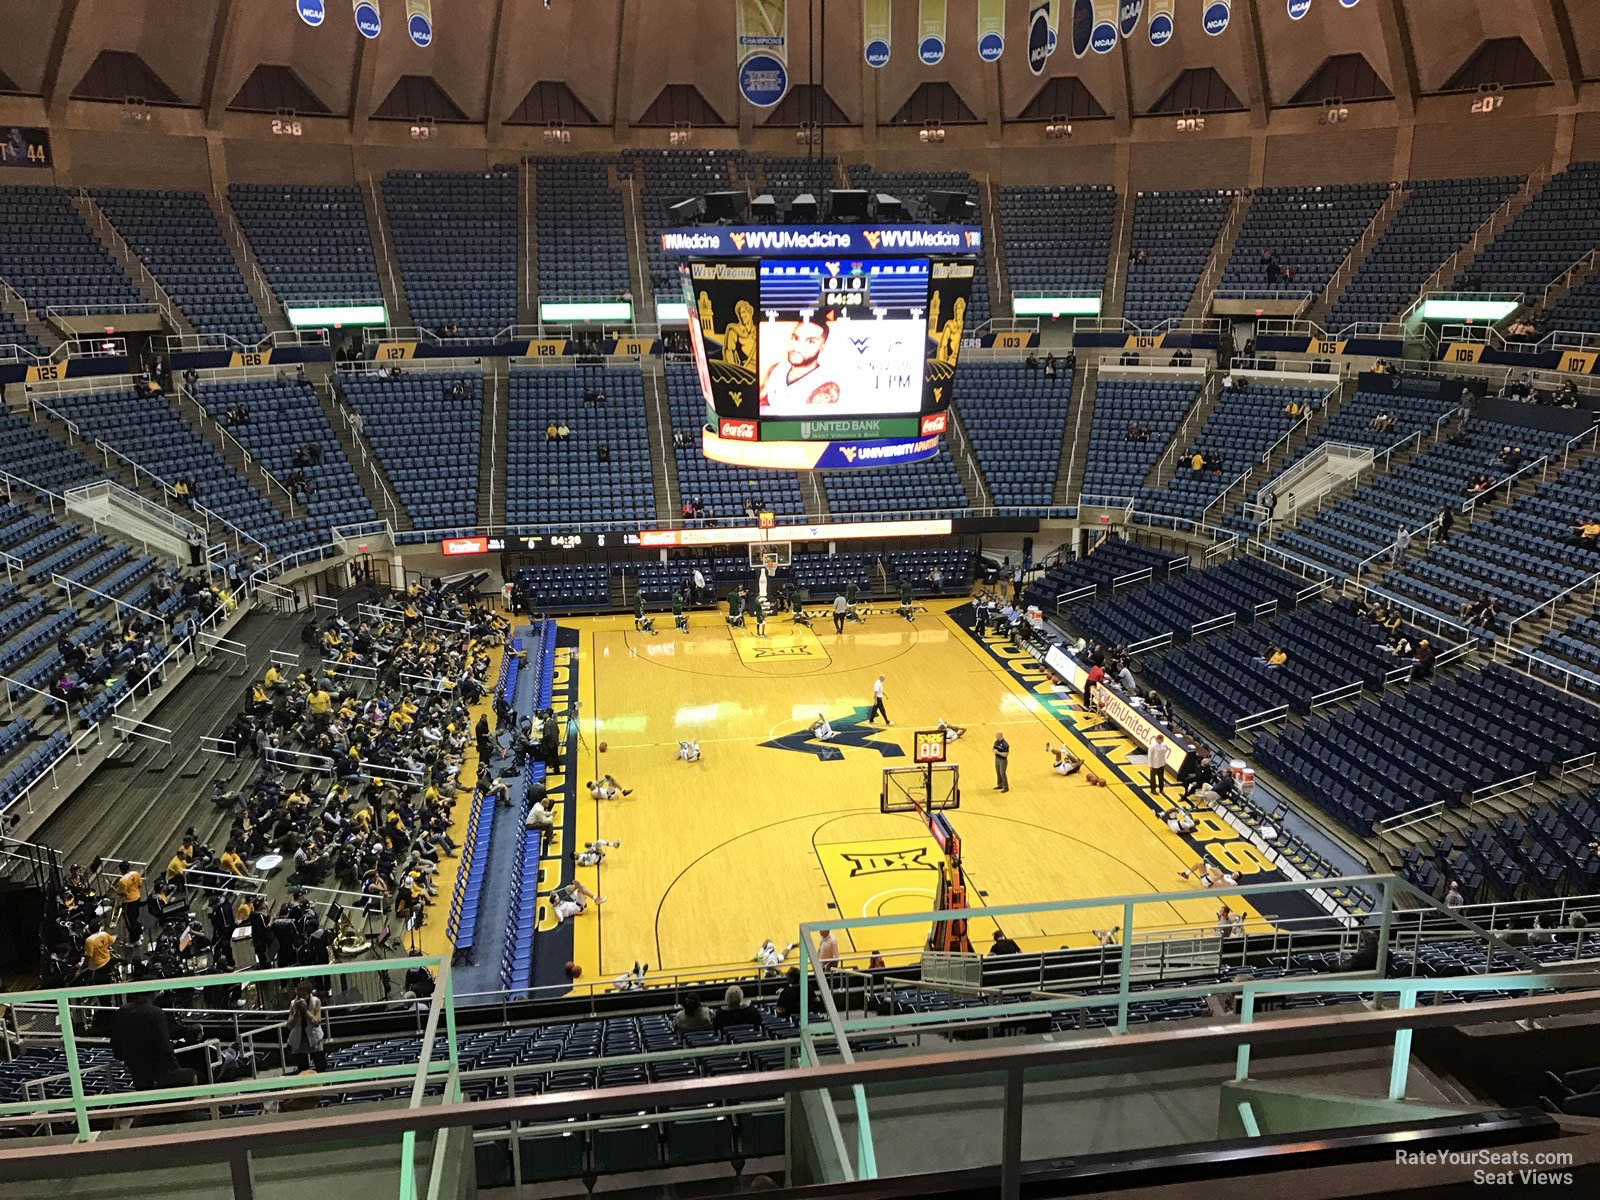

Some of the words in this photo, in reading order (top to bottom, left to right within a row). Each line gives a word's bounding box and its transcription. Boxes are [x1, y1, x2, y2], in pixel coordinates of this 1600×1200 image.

[1291, 2, 1308, 13] NCAA
[303, 9, 322, 19] NCAA
[361, 22, 379, 32] NCAA
[1207, 18, 1227, 29] NCAA
[413, 31, 430, 41] NCAA
[1151, 31, 1170, 40] NCAA
[1094, 38, 1115, 47] NCAA
[923, 51, 943, 59] NCAA
[982, 47, 1002, 56] NCAA
[869, 54, 888, 62] NCAA
[1471, 96, 1504, 113] 207
[27, 144, 45, 162] 44
[829, 278, 838, 289] 0
[852, 278, 861, 289] 0
[1003, 337, 1020, 348] 103
[1136, 338, 1154, 348] 104
[1318, 340, 1336, 353] 105
[387, 348, 405, 359] 127
[537, 345, 556, 356] 128
[627, 344, 641, 355] 101
[241, 354, 261, 366] 126
[1455, 349, 1473, 362] 106
[1568, 358, 1586, 373] 107
[36, 367, 58, 380] 125
[812, 421, 850, 432] UNITED
[852, 420, 880, 430] BANK
[858, 443, 914, 459] UNIVERSITY
[920, 743, 940, 757] 00
